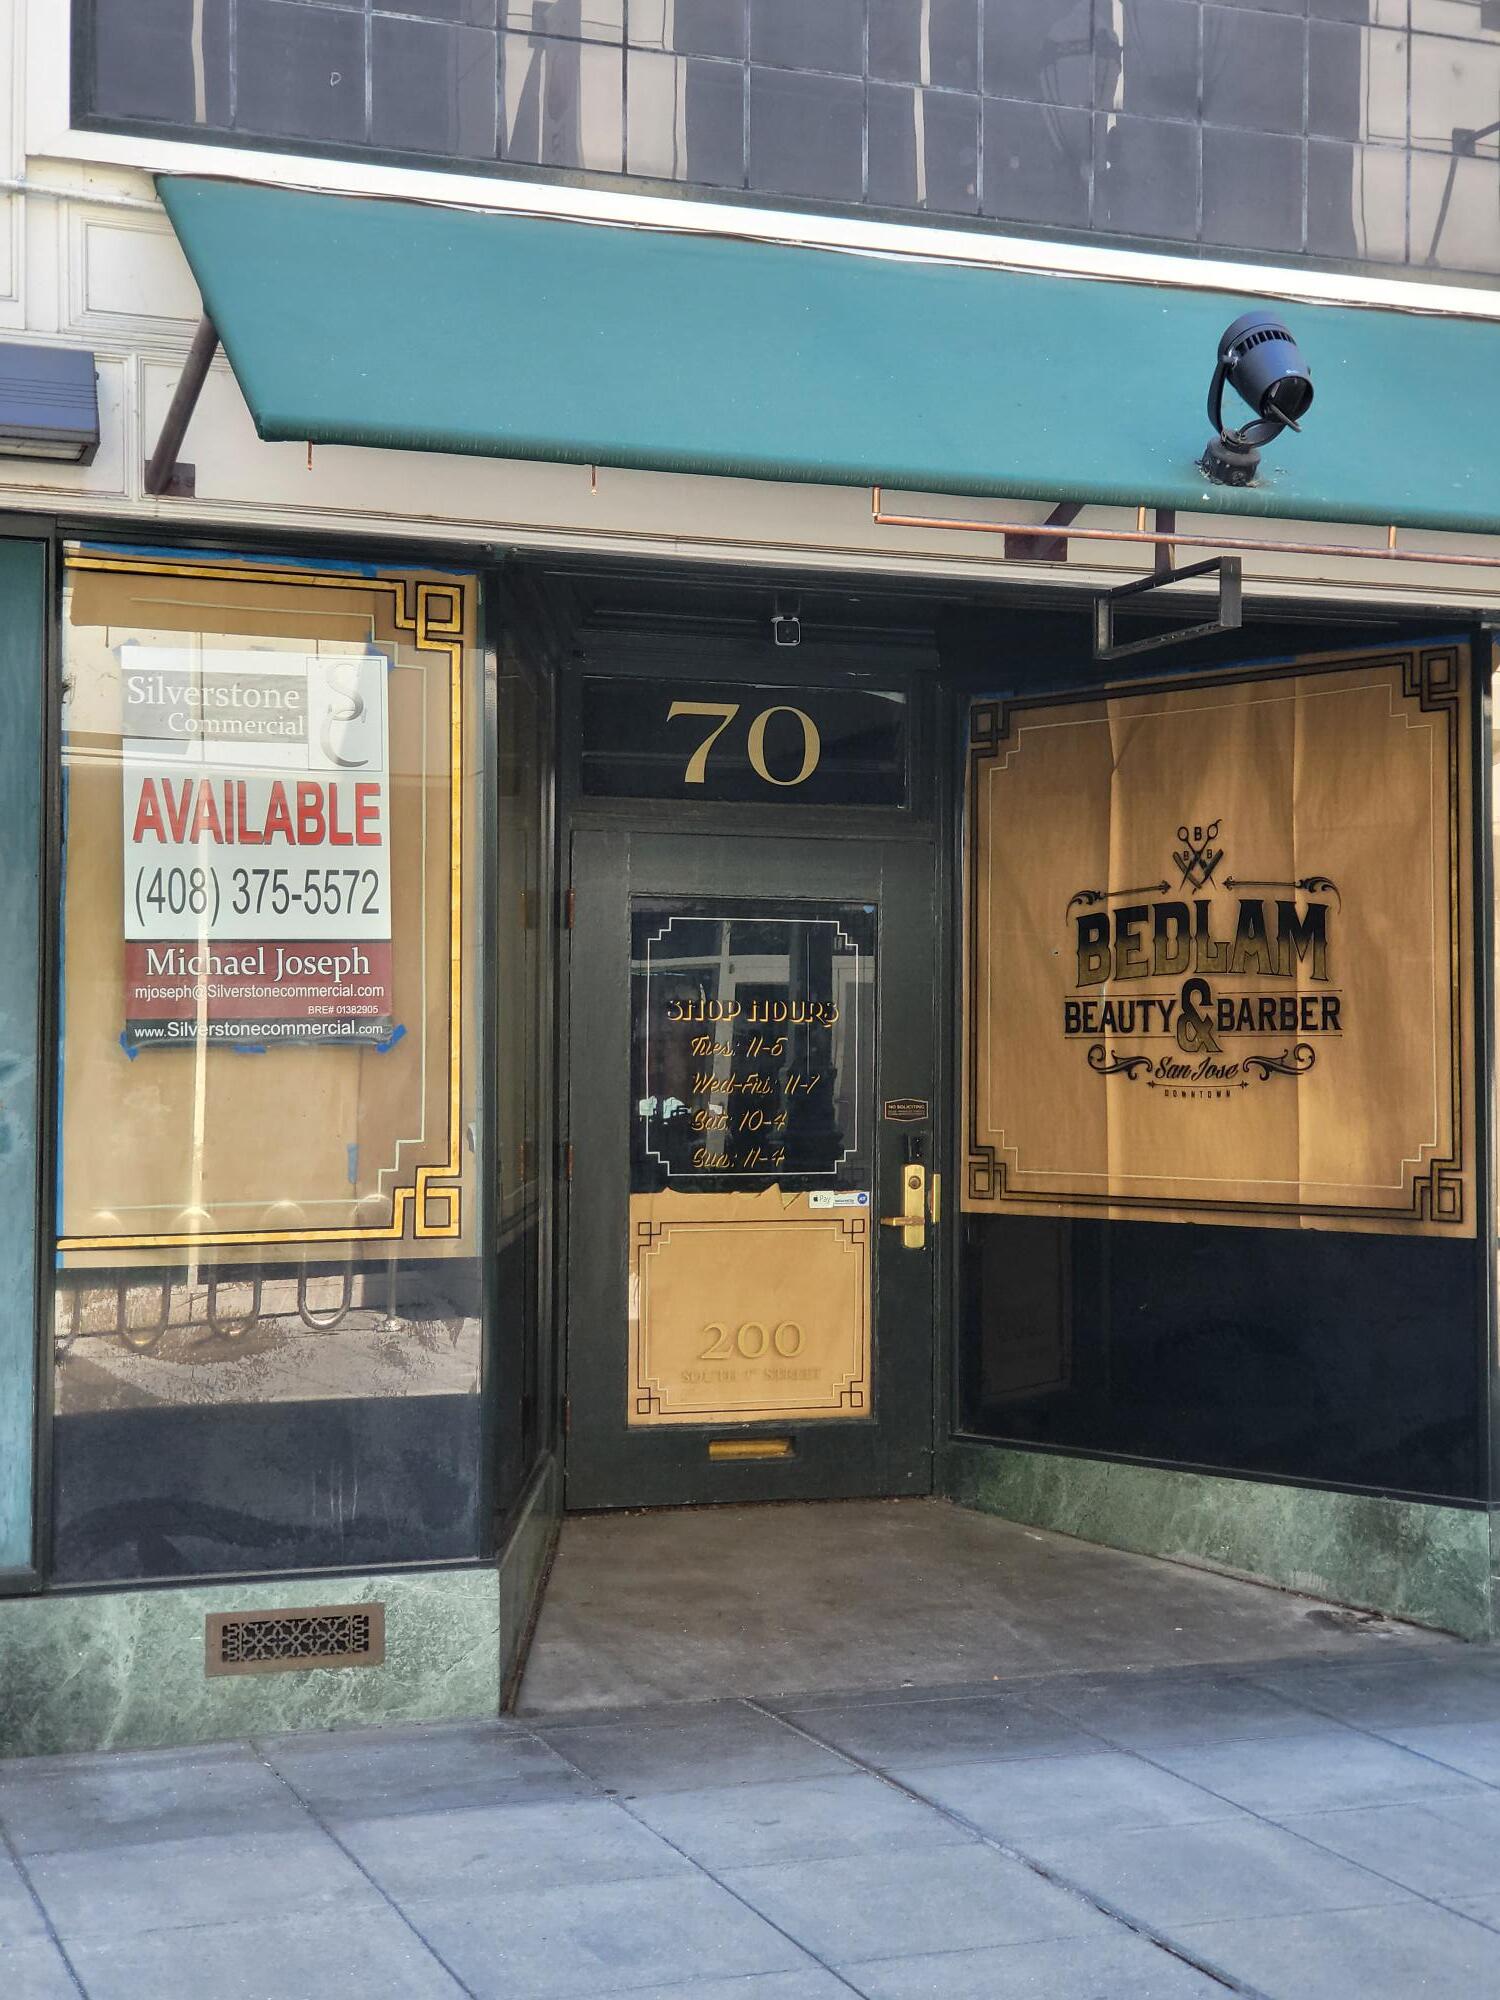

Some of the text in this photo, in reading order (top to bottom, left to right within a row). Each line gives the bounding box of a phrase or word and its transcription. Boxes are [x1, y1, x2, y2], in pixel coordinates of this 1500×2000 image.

[127, 675, 300, 709] Silverstone
[168, 712, 305, 736] Commercial
[666, 700, 821, 786] 70
[132, 777, 383, 846] AVAILABLE
[135, 866, 380, 928] (408) 375-5572
[1075, 898, 1329, 988] BEDLAM
[145, 946, 371, 983] Michael Joseph
[134, 983, 385, 1001] mjoseph@Silverstonecommercial.com
[307, 1005, 335, 1015] BRE#
[667, 999, 841, 1028] SHOP HOURS
[1064, 977, 1343, 1053] BEAUTY & BARBER
[134, 1020, 384, 1039] www.Silverstonecommercial.com
[746, 1035, 789, 1058] 11-5
[1154, 1055, 1240, 1081] San Jose
[1164, 1089, 1231, 1098] DOWNTOWN
[699, 1318, 805, 1361] 200
